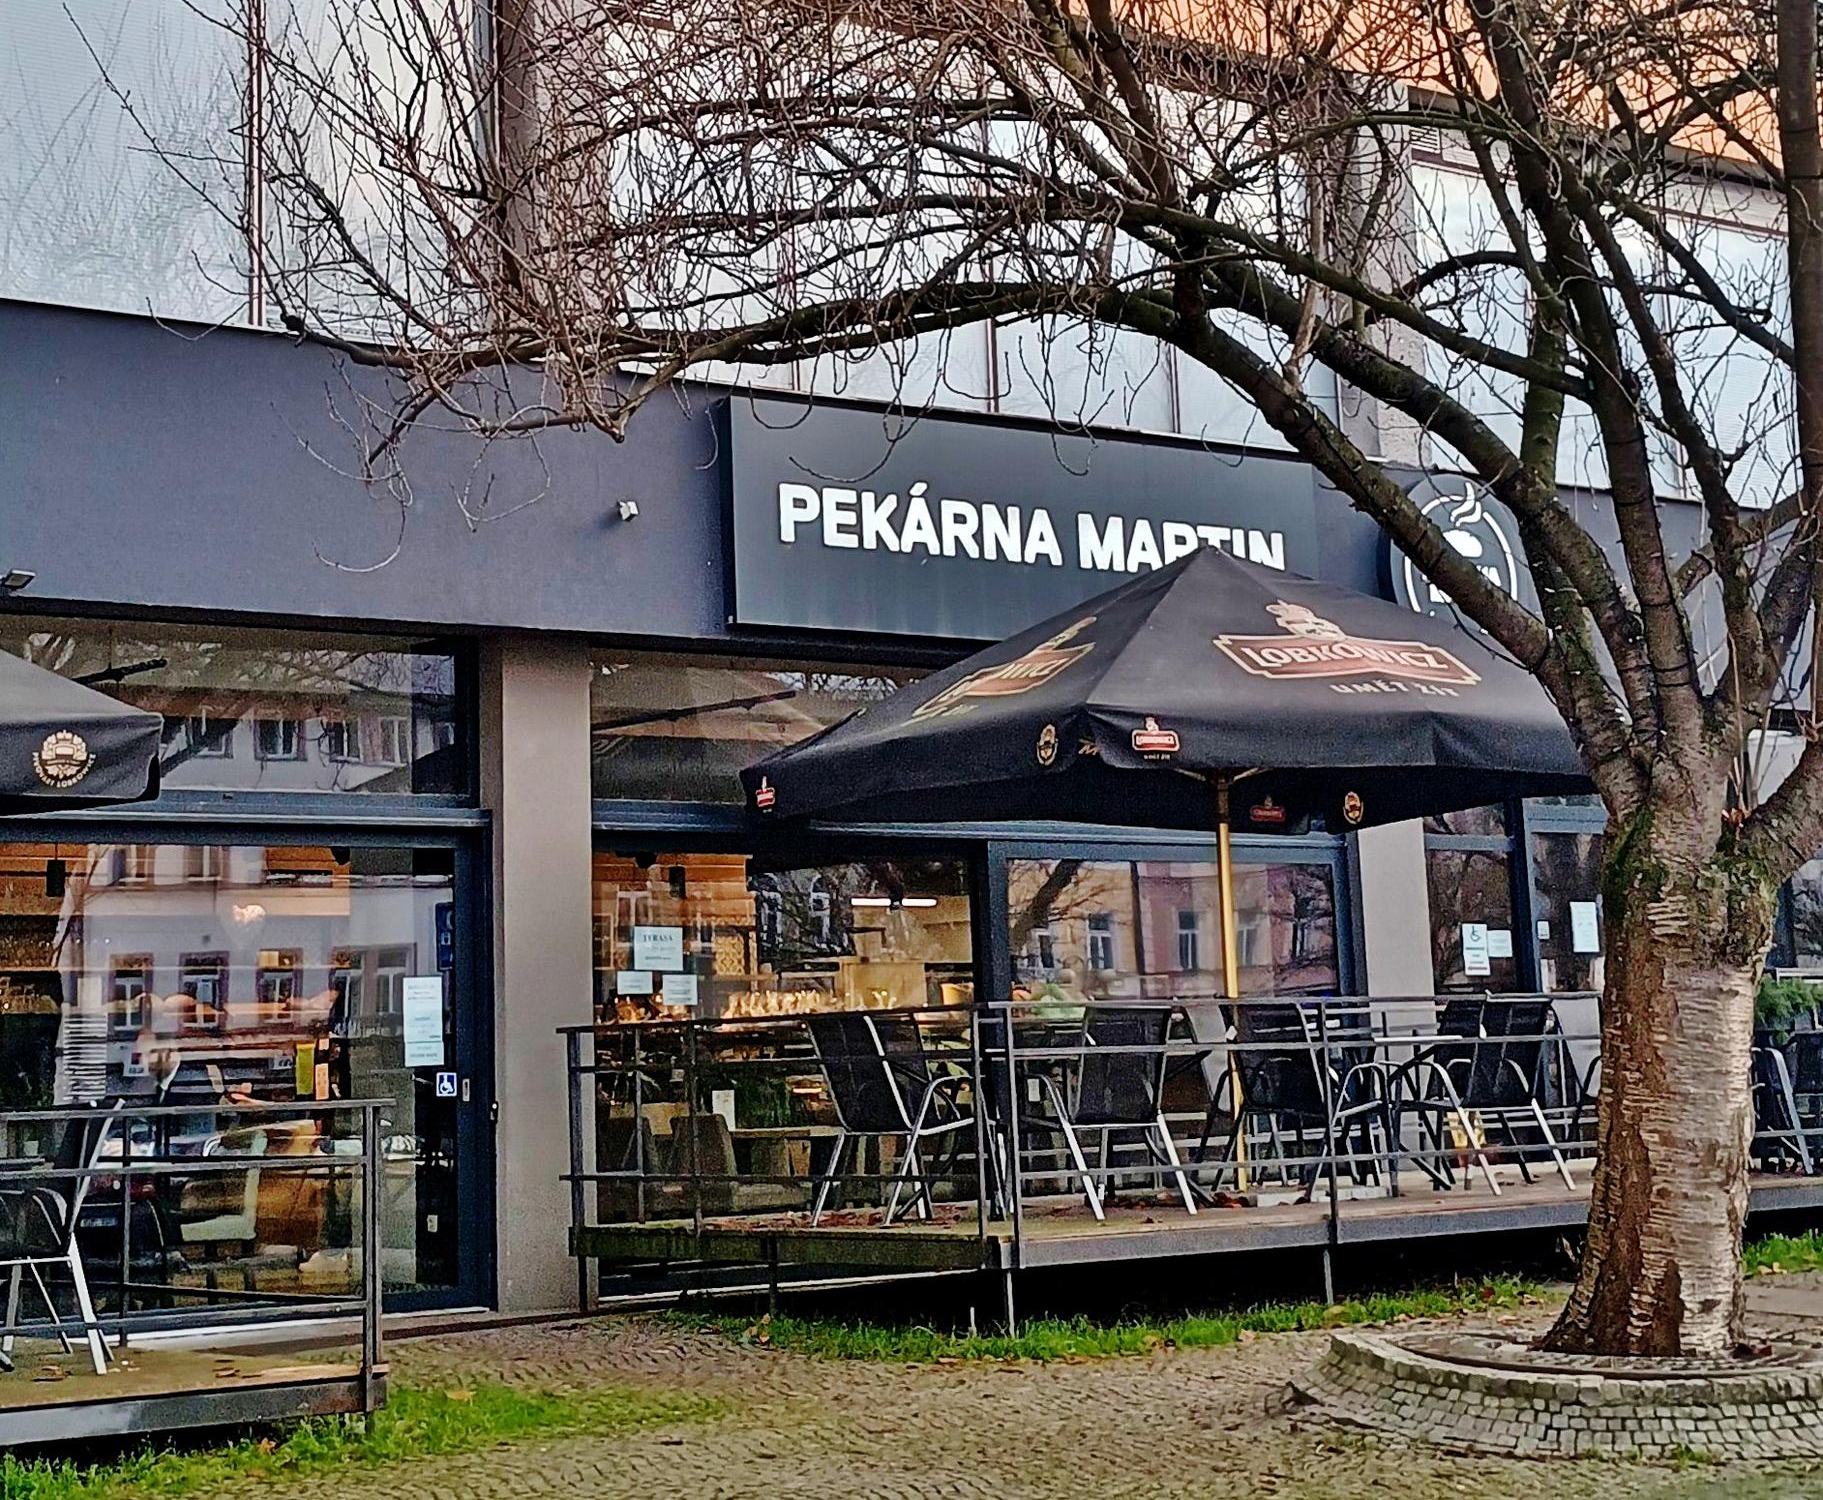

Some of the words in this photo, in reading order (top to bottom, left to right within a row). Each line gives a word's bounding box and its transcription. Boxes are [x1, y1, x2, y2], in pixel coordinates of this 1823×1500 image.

[778, 481, 1063, 567] PEKÁRNA
[1077, 512, 1286, 573] MARTIN
[1240, 642, 1449, 669] LOBKOWICZ
